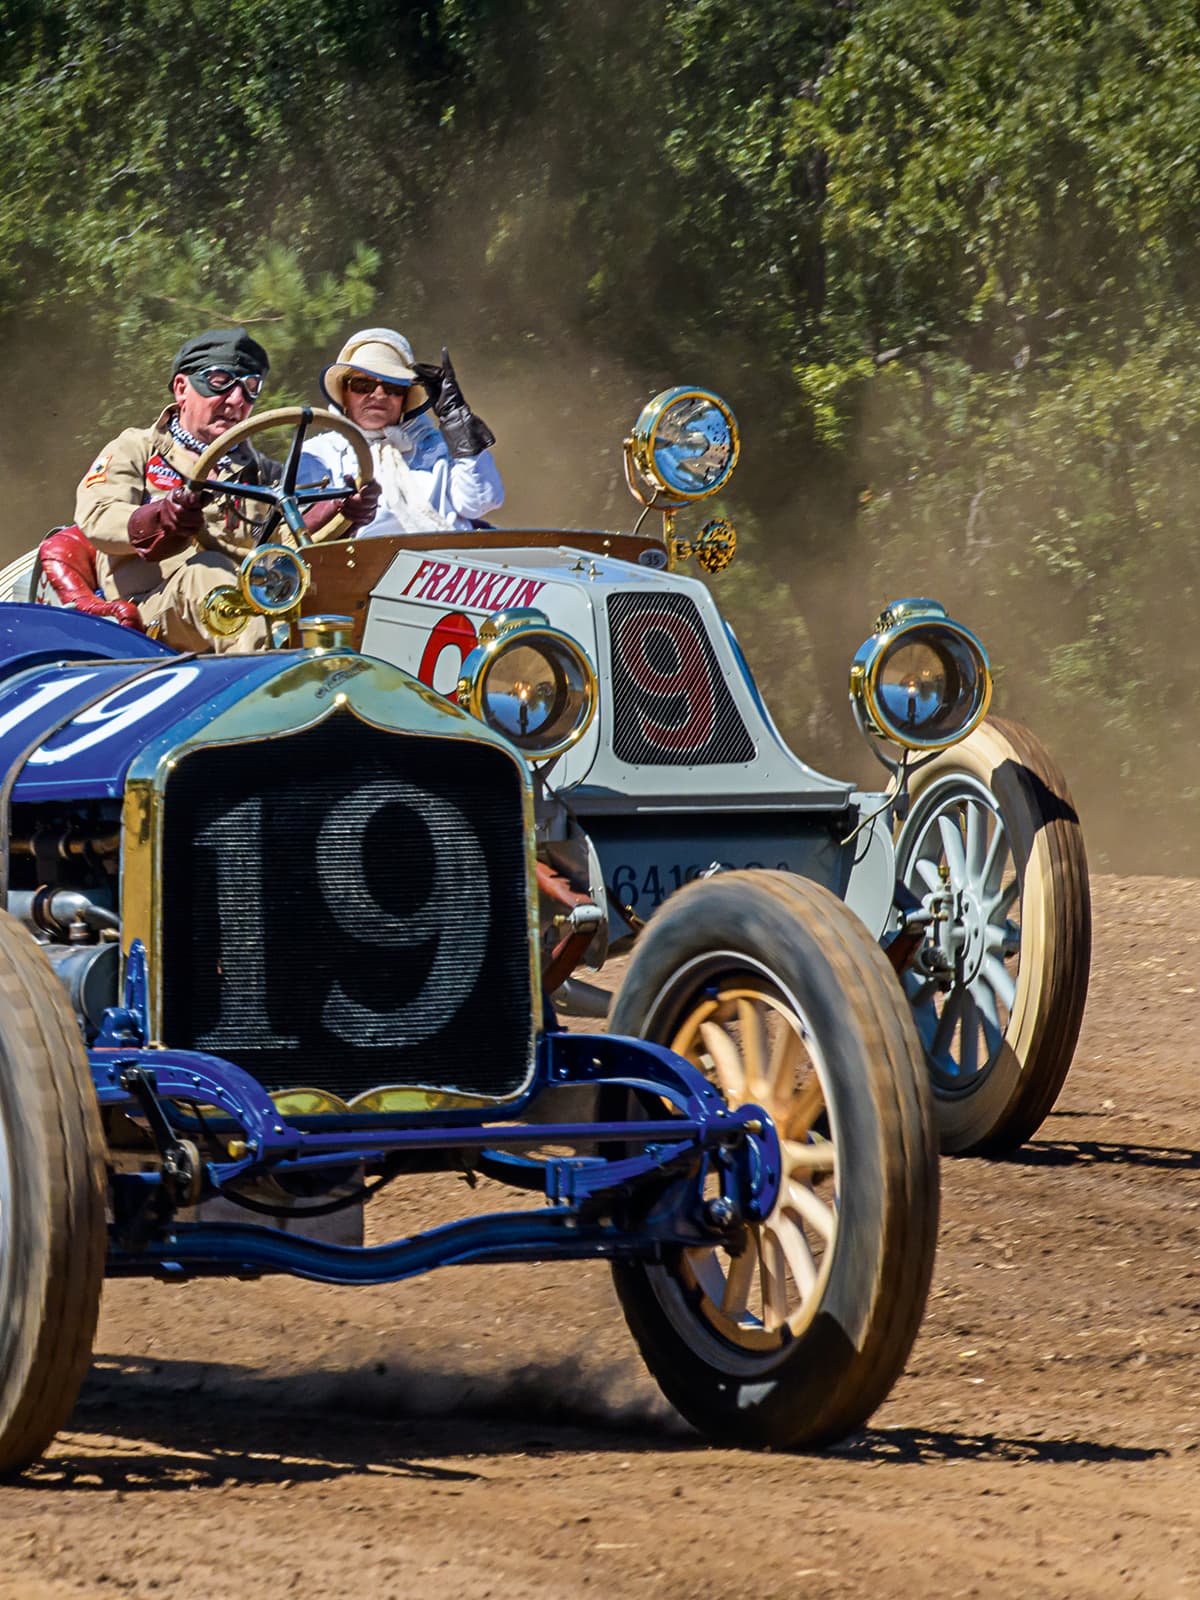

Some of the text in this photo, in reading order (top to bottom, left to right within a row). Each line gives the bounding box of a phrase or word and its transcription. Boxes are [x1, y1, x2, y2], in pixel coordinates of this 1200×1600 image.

[400, 560, 548, 612] FRANKLIN
[614, 609, 716, 752] 9
[191, 780, 491, 1050] 19
